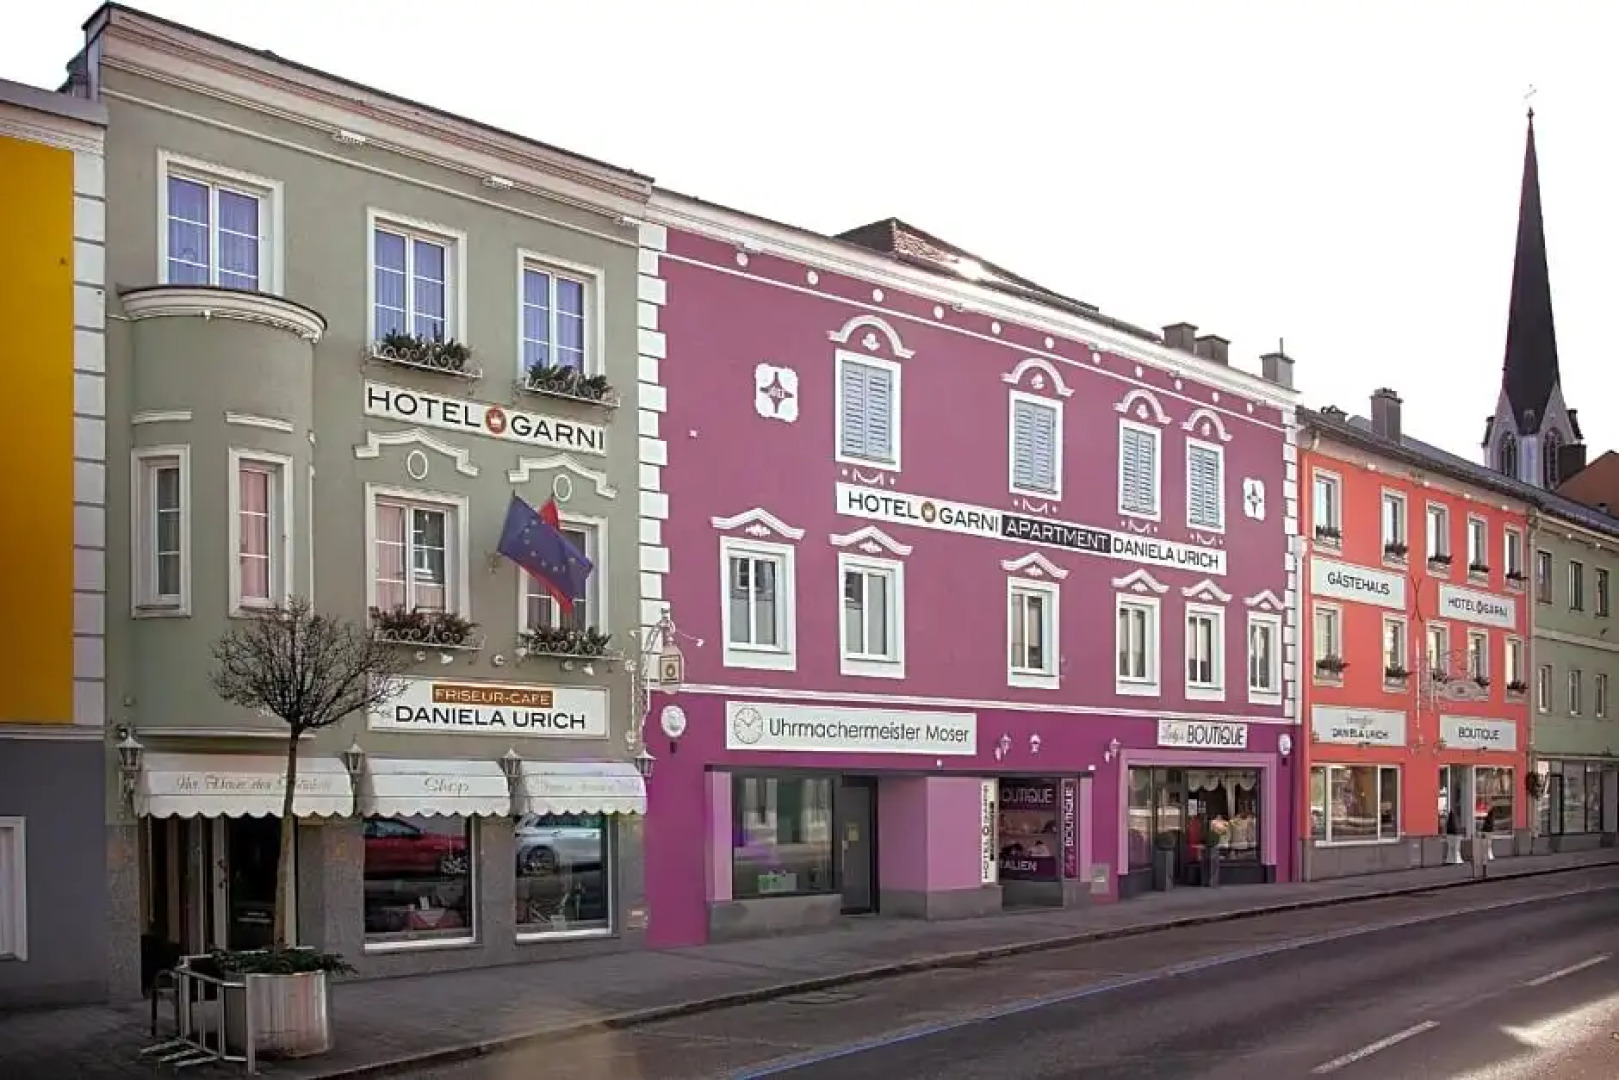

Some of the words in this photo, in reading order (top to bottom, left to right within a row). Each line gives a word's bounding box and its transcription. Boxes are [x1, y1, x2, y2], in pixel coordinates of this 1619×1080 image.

[367, 386, 482, 428] HOTEL
[510, 415, 605, 451] GARNI
[848, 490, 919, 520] HOTEL
[939, 506, 999, 531] GARNI
[1005, 515, 1109, 552] APARTMENT
[1113, 537, 1175, 562] DANIELA
[1177, 550, 1219, 569] URICH
[1327, 571, 1391, 595] GÄSTEHAUS
[1448, 596, 1476, 611] HOTEL
[435, 688, 550, 705] FRISEUR-CAFE
[395, 705, 506, 727] DANIELA
[512, 711, 586, 729] URICH
[768, 717, 920, 742] Uhrmachermeister
[925, 724, 970, 743] Moser
[1186, 724, 1245, 746] BOUTIQUE
[1458, 726, 1500, 740] BOUTIQUE
[424, 775, 470, 796] Shop
